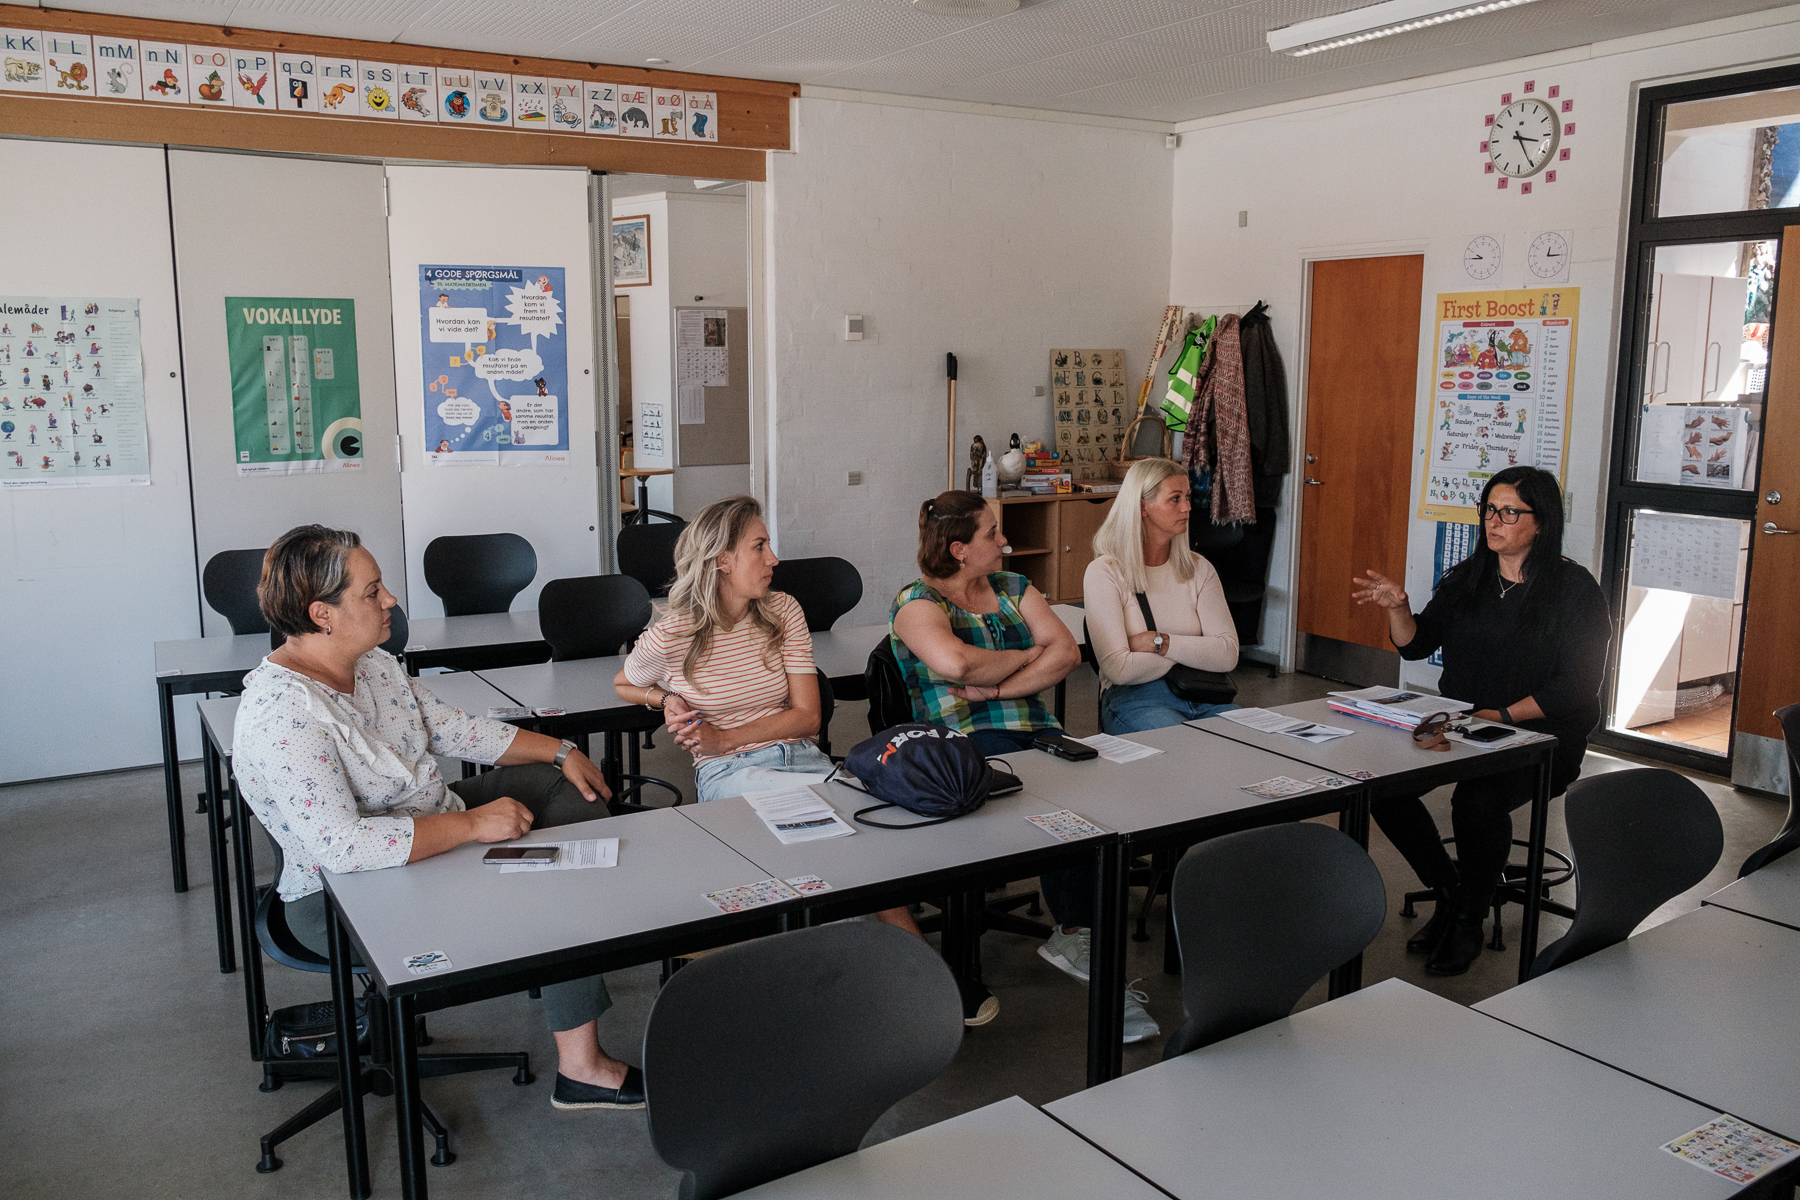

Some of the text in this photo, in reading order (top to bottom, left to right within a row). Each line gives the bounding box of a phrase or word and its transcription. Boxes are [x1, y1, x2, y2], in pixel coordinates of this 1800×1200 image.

[426, 269, 519, 279] 4 GODE SPØRGSMÅL
[1442, 298, 1535, 319] First Boost
[243, 307, 342, 325] VOKALLYDE
[1447, 430, 1469, 438] Saturday
[1494, 433, 1521, 441] Wednesday
[1462, 443, 1479, 451] Friday
[1486, 444, 1509, 452] Thursday
